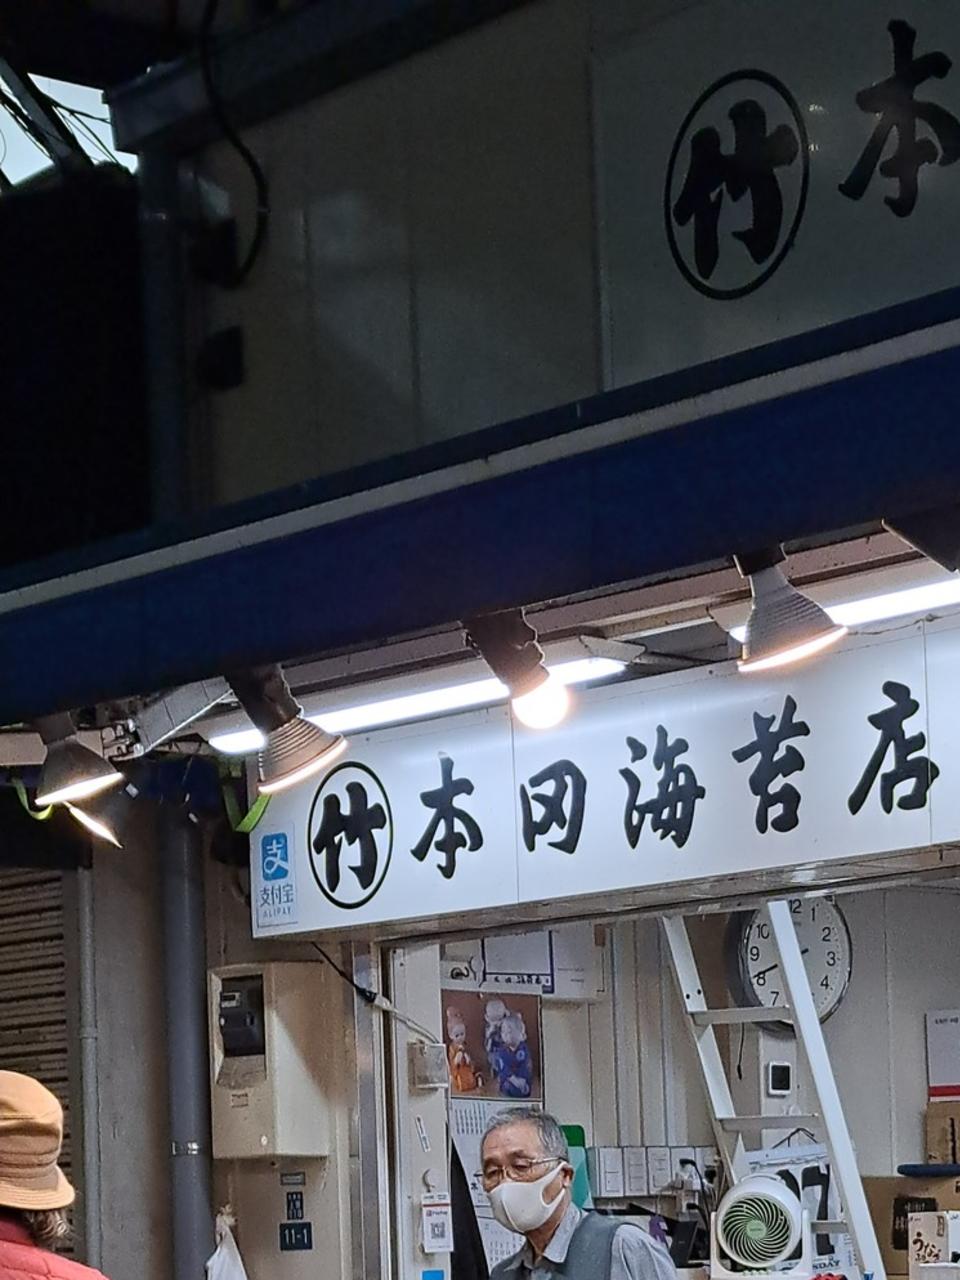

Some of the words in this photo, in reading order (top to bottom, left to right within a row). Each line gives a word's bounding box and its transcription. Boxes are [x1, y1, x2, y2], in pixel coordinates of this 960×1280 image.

[260, 884, 294, 908] 支付宝
[263, 907, 292, 919] ALIPAY
[283, 1228, 310, 1247] 11-1
